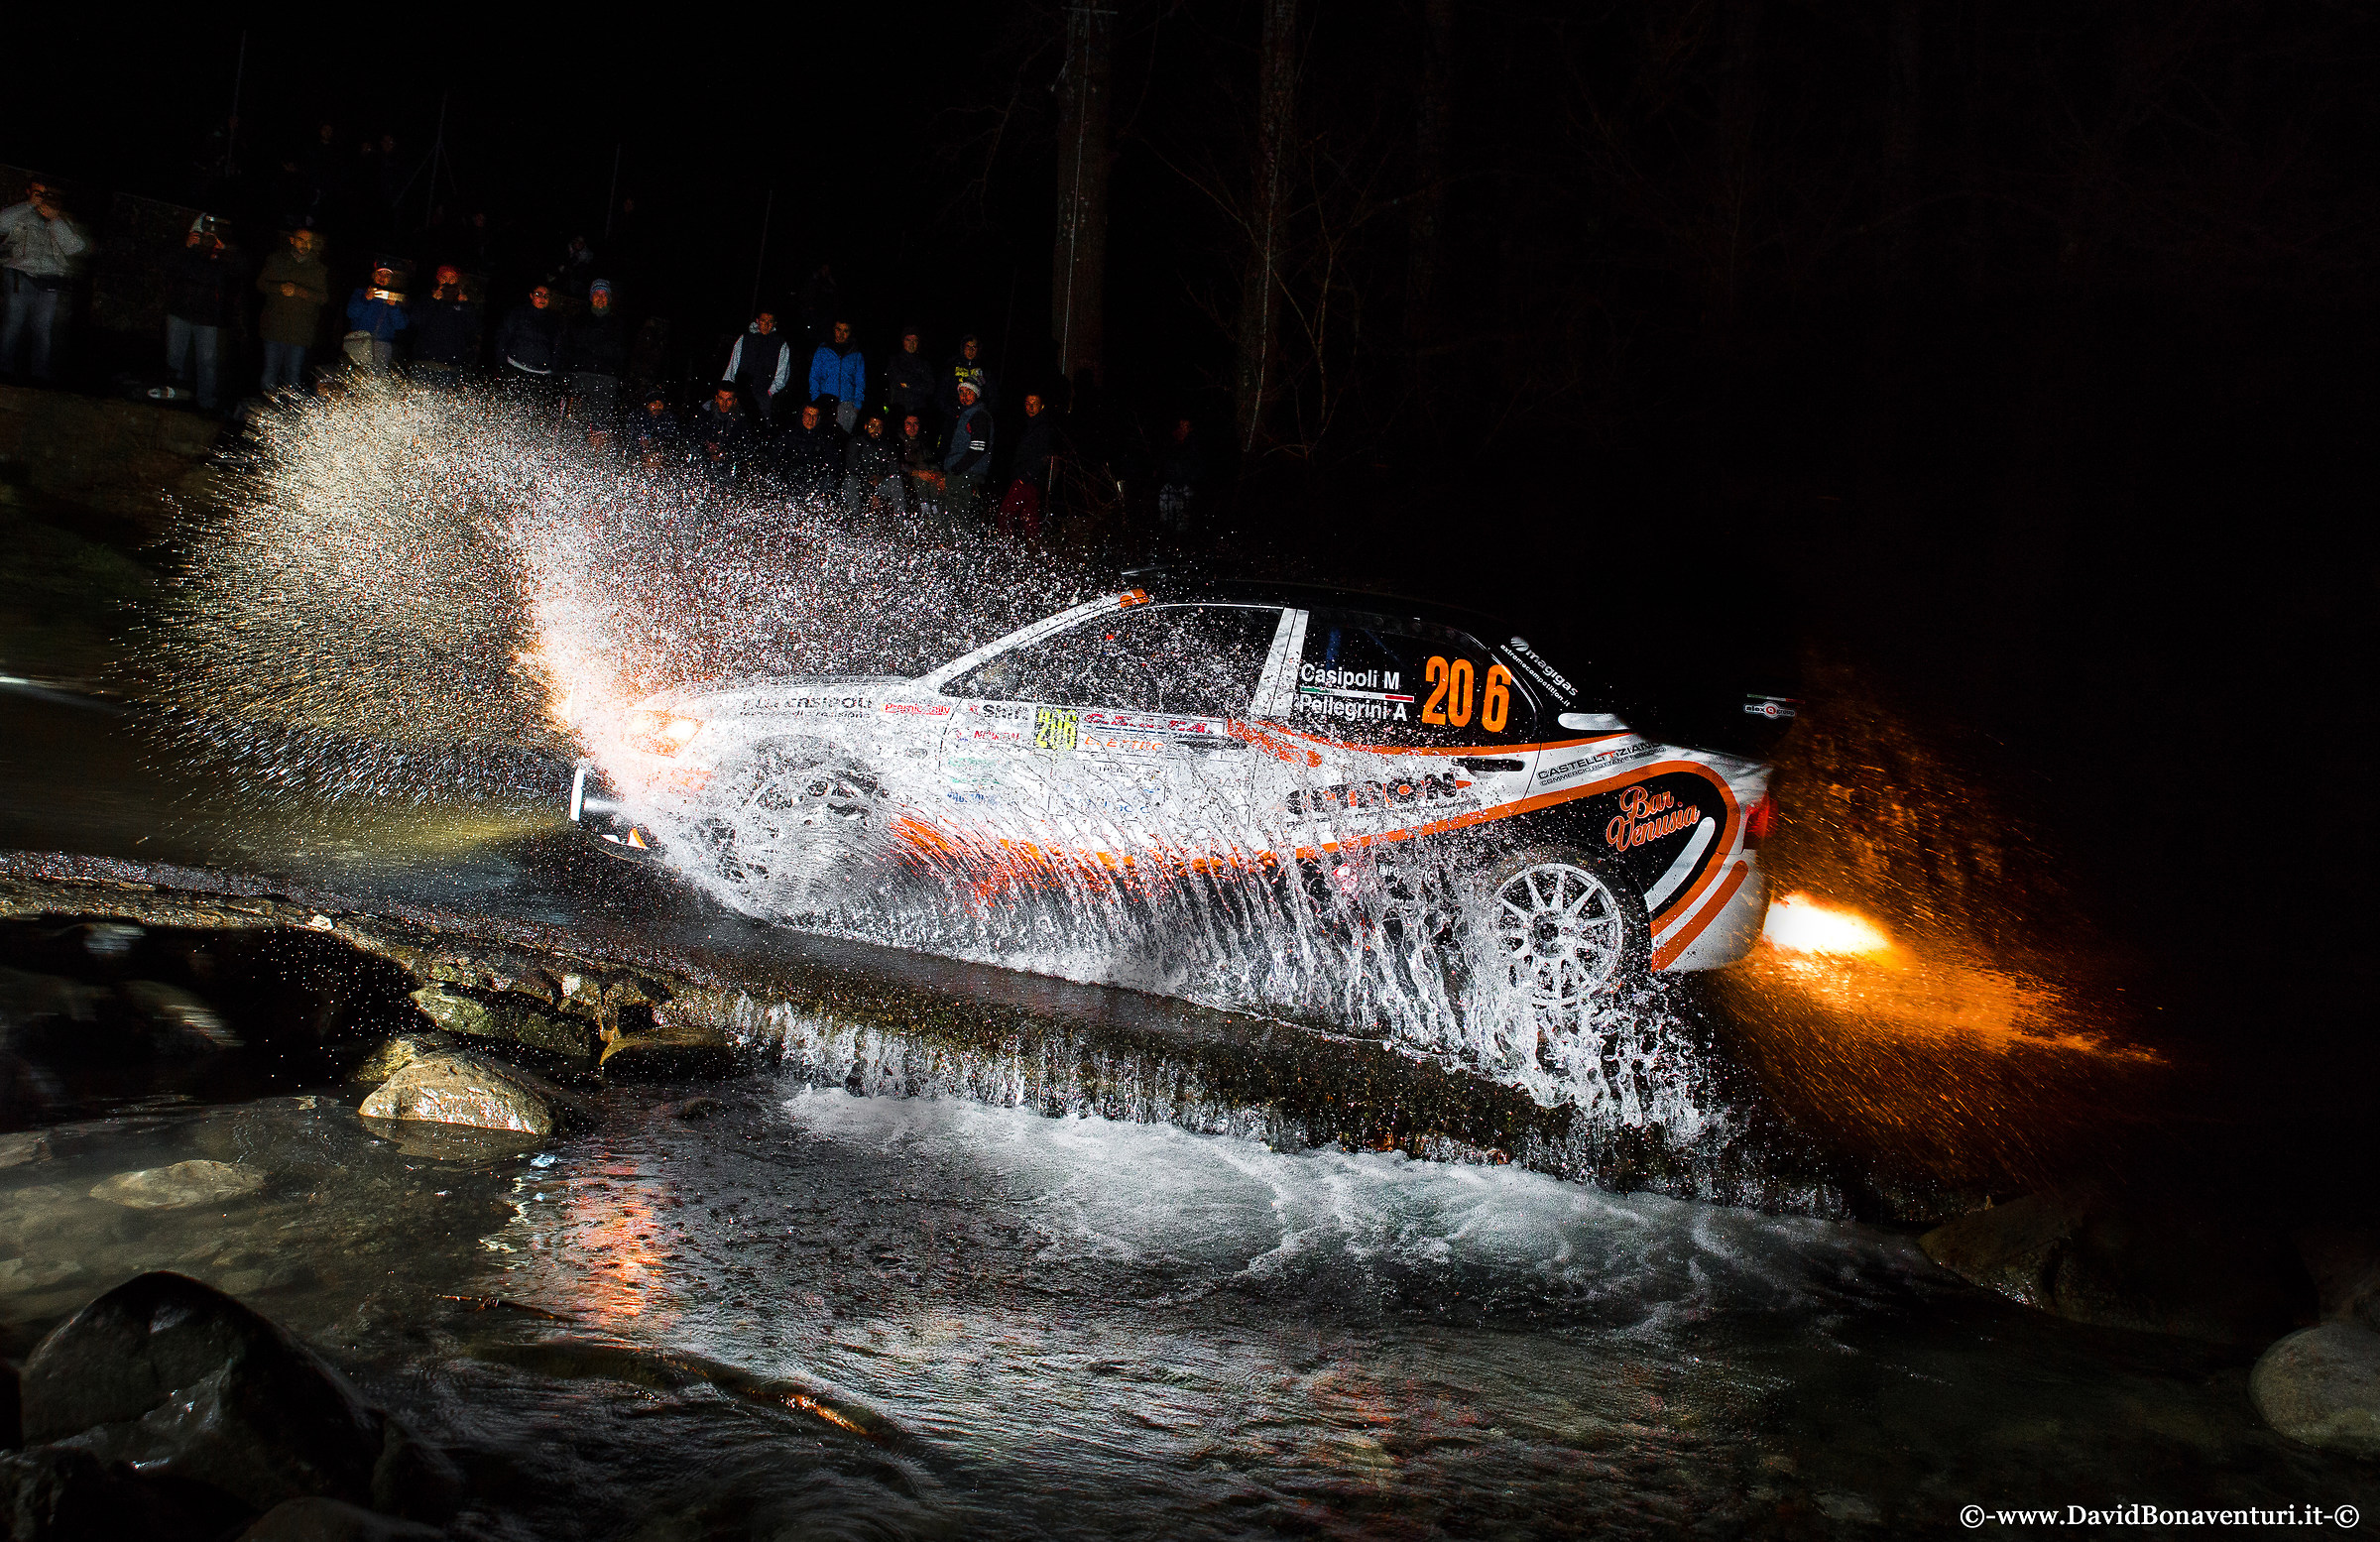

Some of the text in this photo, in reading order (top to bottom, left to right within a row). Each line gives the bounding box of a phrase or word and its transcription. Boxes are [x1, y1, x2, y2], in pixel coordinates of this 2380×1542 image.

[1300, 663, 1399, 690] Casipoli M
[1499, 645, 1571, 707] extremecompetition.it
[1525, 649, 1579, 696] magigas
[1299, 694, 1408, 722] Pellegrini A
[1619, 786, 1674, 819] Bar
[1606, 801, 1701, 852] Venusia
